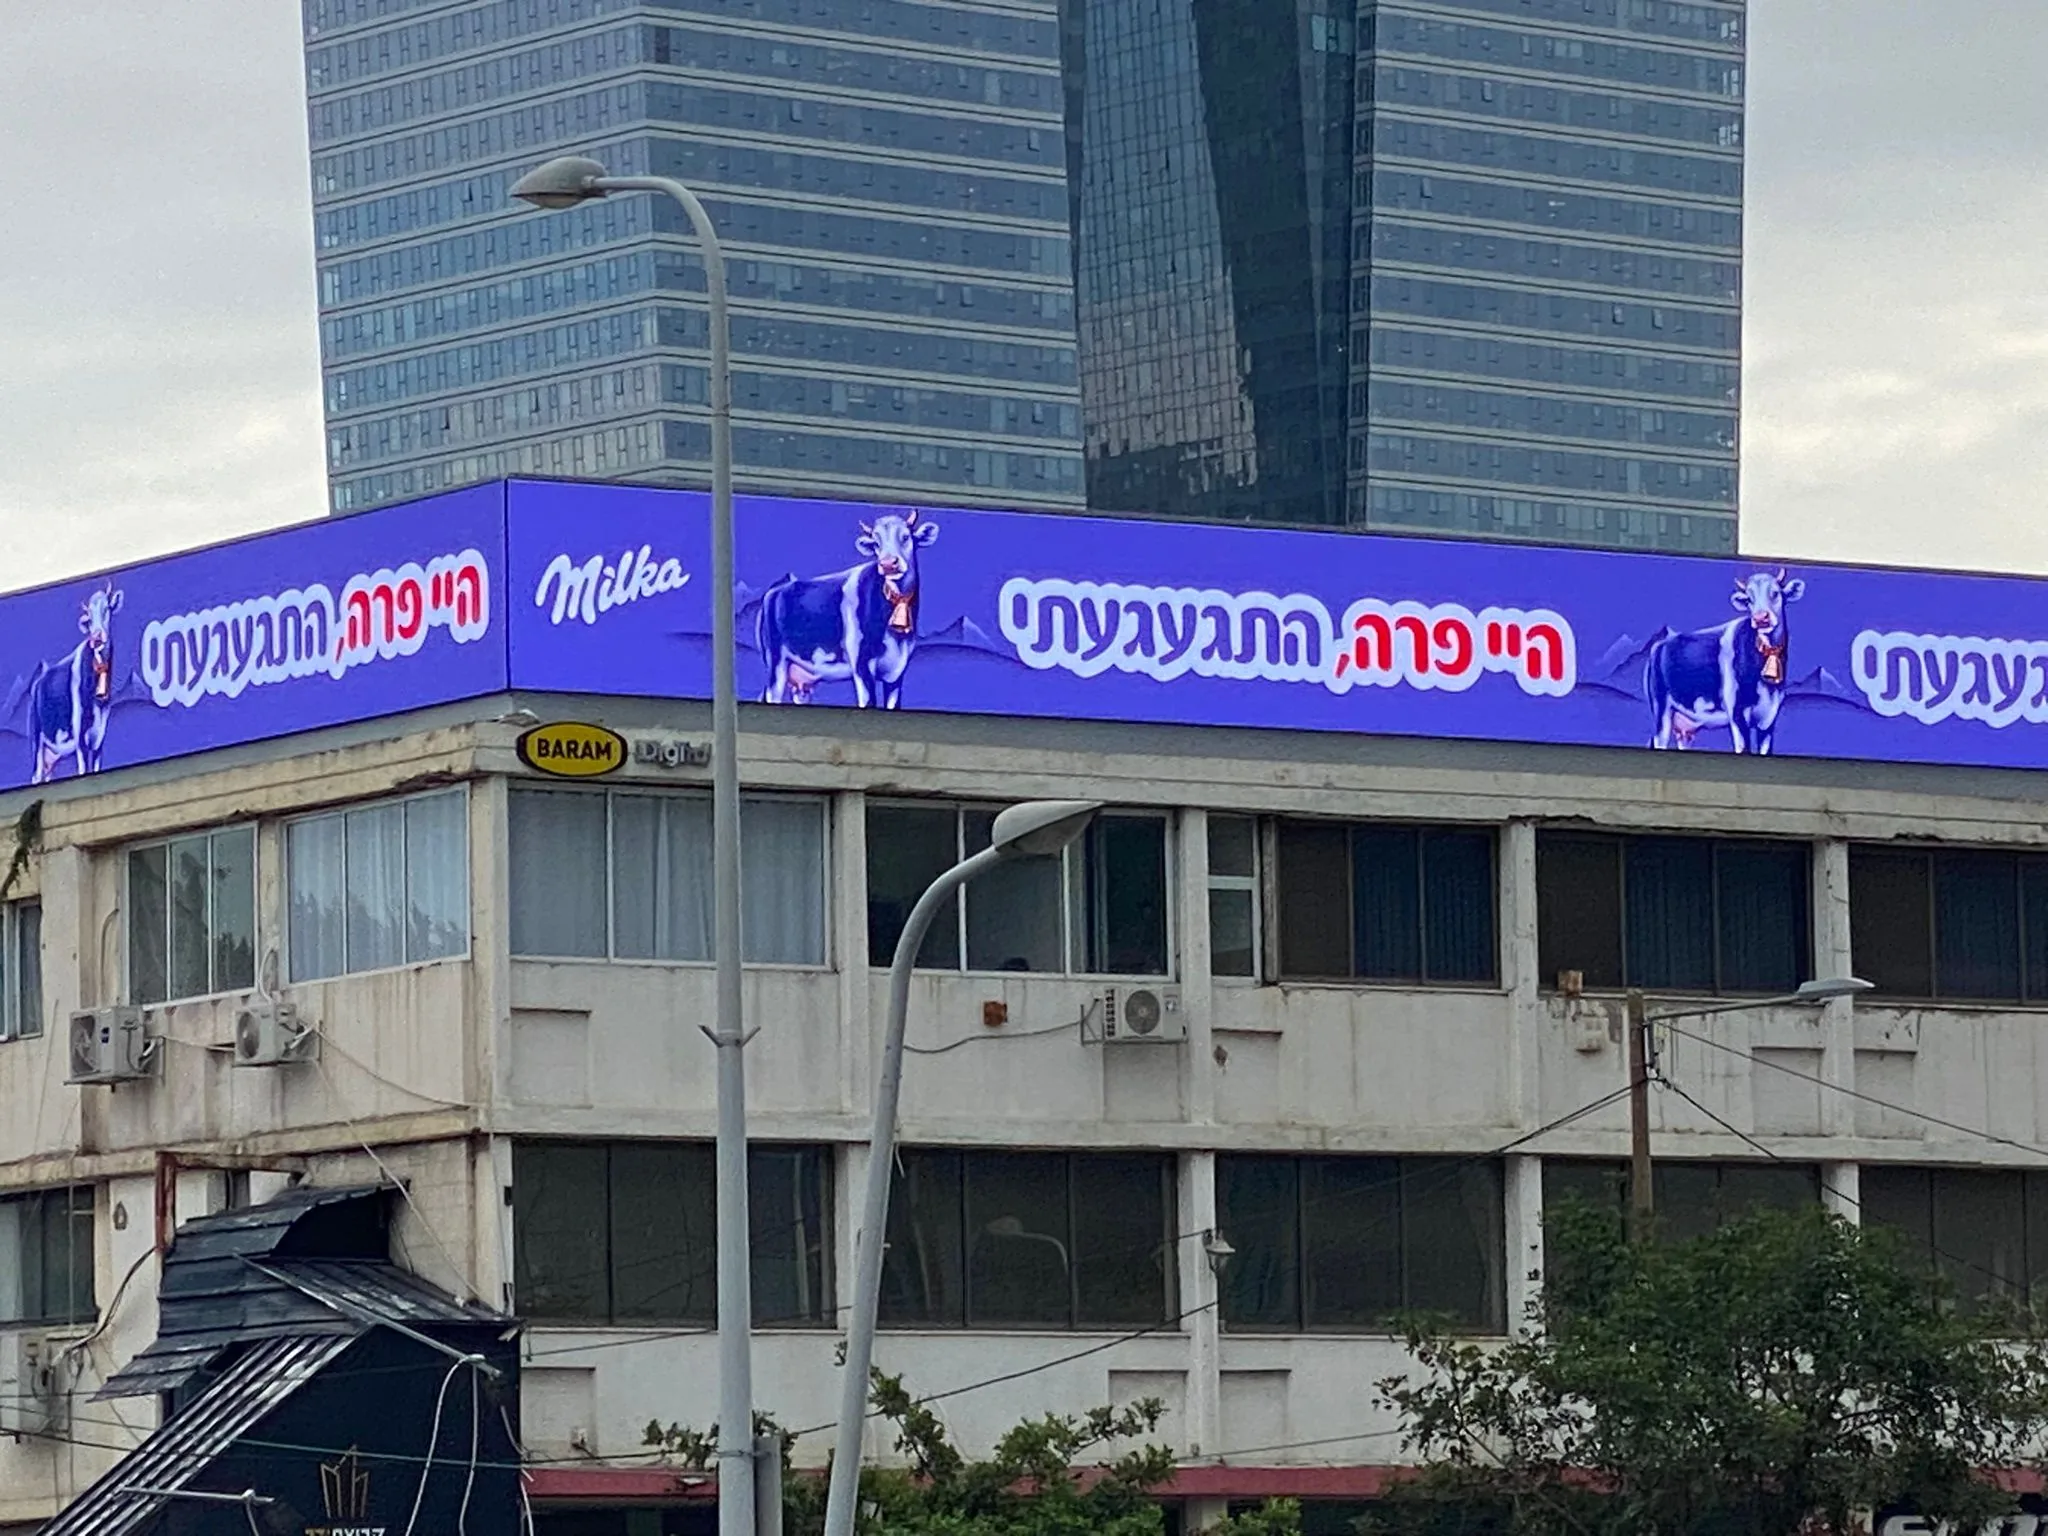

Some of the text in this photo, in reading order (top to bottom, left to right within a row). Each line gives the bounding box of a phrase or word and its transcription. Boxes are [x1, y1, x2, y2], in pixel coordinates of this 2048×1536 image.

[536, 545, 690, 625] Milka
[149, 565, 481, 692] היי פרה, התגעגעתי
[1012, 592, 1564, 681] היי פרה, התגעגעתי
[537, 737, 612, 760] BARAM
